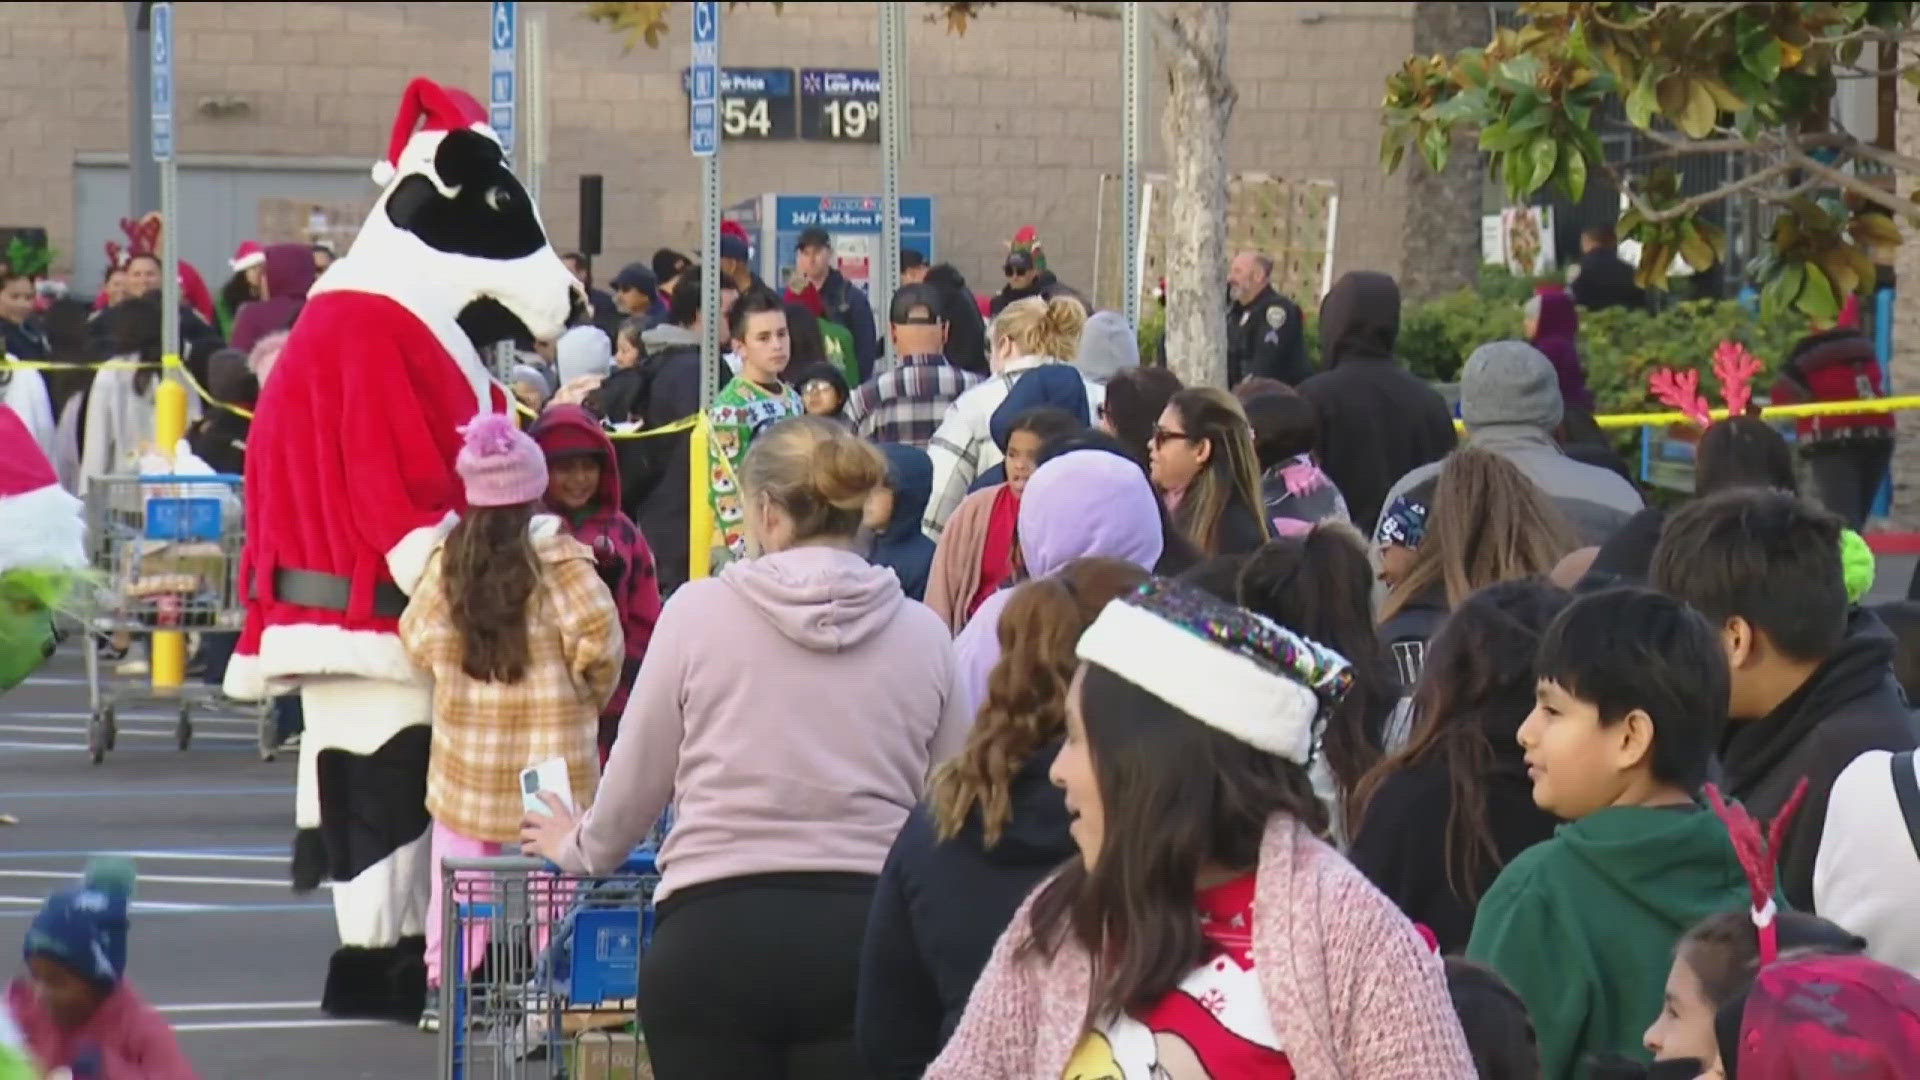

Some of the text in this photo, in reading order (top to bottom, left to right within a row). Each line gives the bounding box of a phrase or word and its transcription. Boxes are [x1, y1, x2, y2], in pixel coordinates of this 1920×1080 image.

[733, 75, 765, 90] Price
[792, 211, 915, 226] 24/7 Self-Serve Pane
